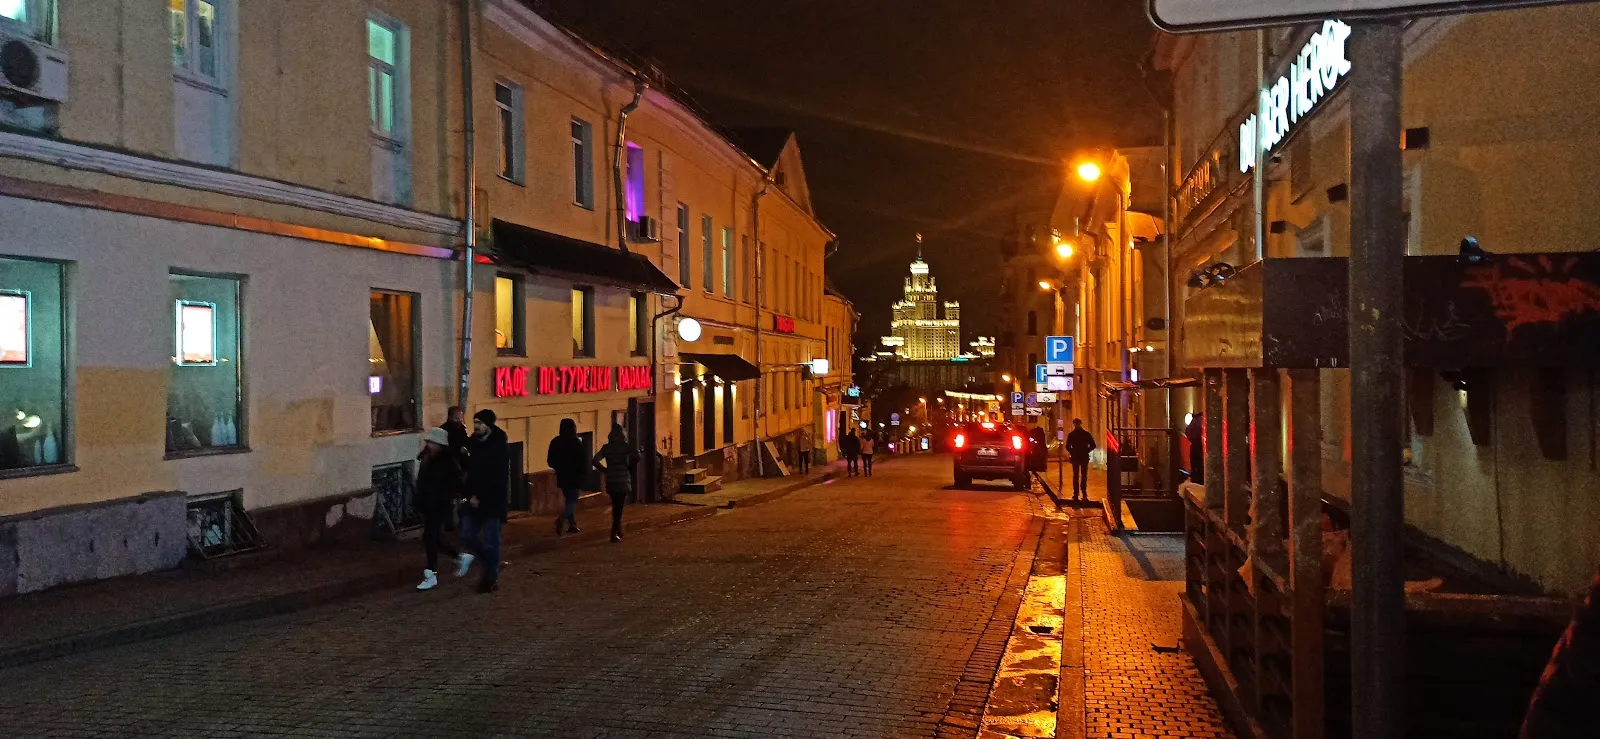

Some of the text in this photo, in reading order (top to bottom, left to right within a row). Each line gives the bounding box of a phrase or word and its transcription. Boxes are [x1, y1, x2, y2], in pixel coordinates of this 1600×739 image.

[1239, 75, 1290, 173] BUGER
[1053, 339, 1068, 360] P
[495, 365, 651, 397] КАФЕ ПО-ТУРЕЦКИ БАРДАК
[1014, 393, 1022, 402] P
